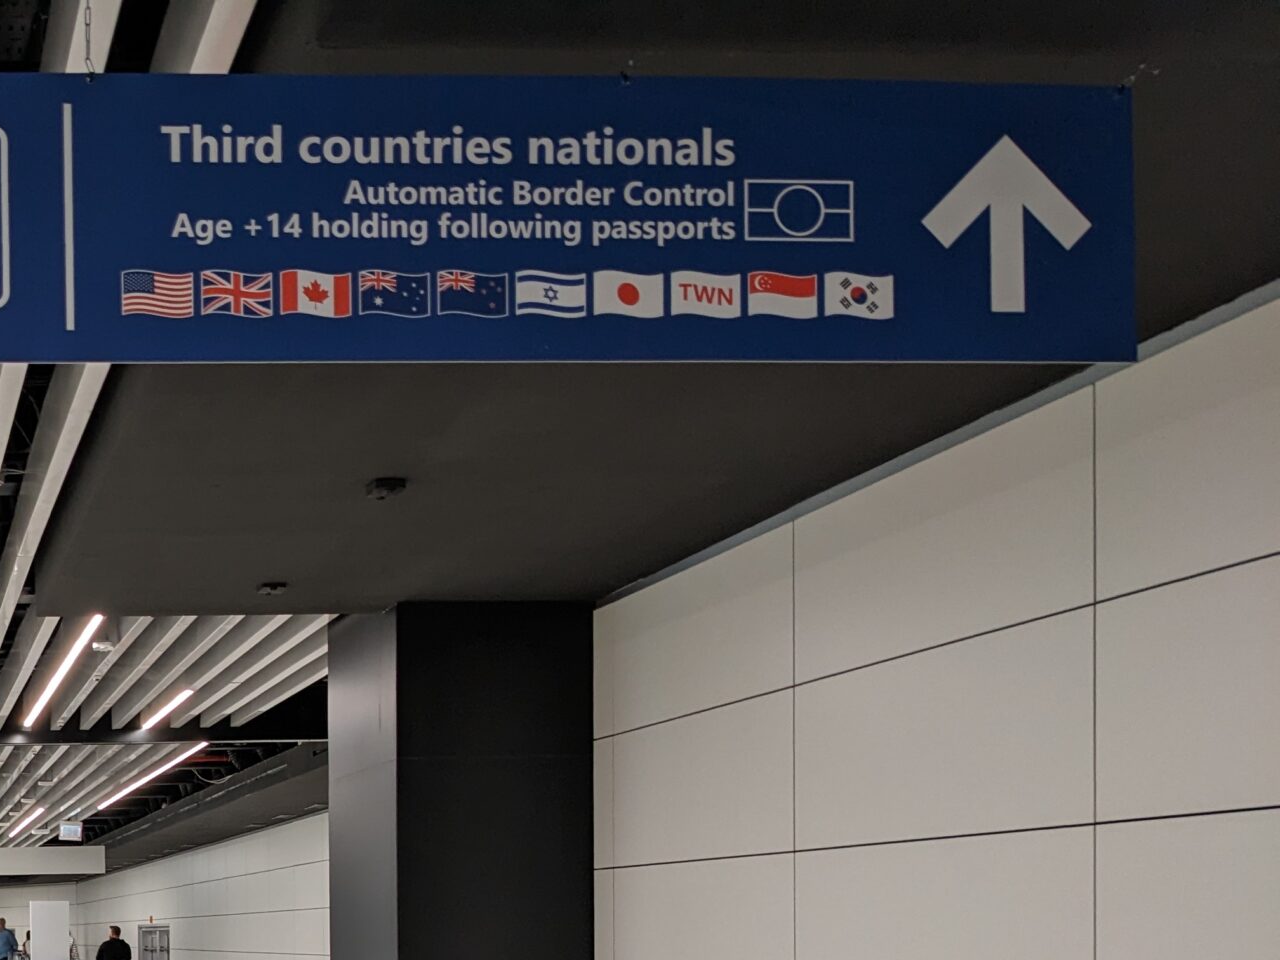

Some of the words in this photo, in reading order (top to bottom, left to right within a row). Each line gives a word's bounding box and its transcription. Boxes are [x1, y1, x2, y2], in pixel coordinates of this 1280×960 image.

[161, 124, 282, 164] Third
[298, 126, 513, 165] countries
[528, 127, 735, 166] nationals
[343, 179, 503, 206] Automatic
[513, 179, 615, 206] Border
[623, 180, 734, 207] Control
[171, 212, 233, 246] Age
[244, 212, 303, 238] +14
[312, 212, 428, 246] holding
[437, 212, 581, 247] following
[592, 217, 736, 247] passports
[679, 283, 735, 306] TWN
